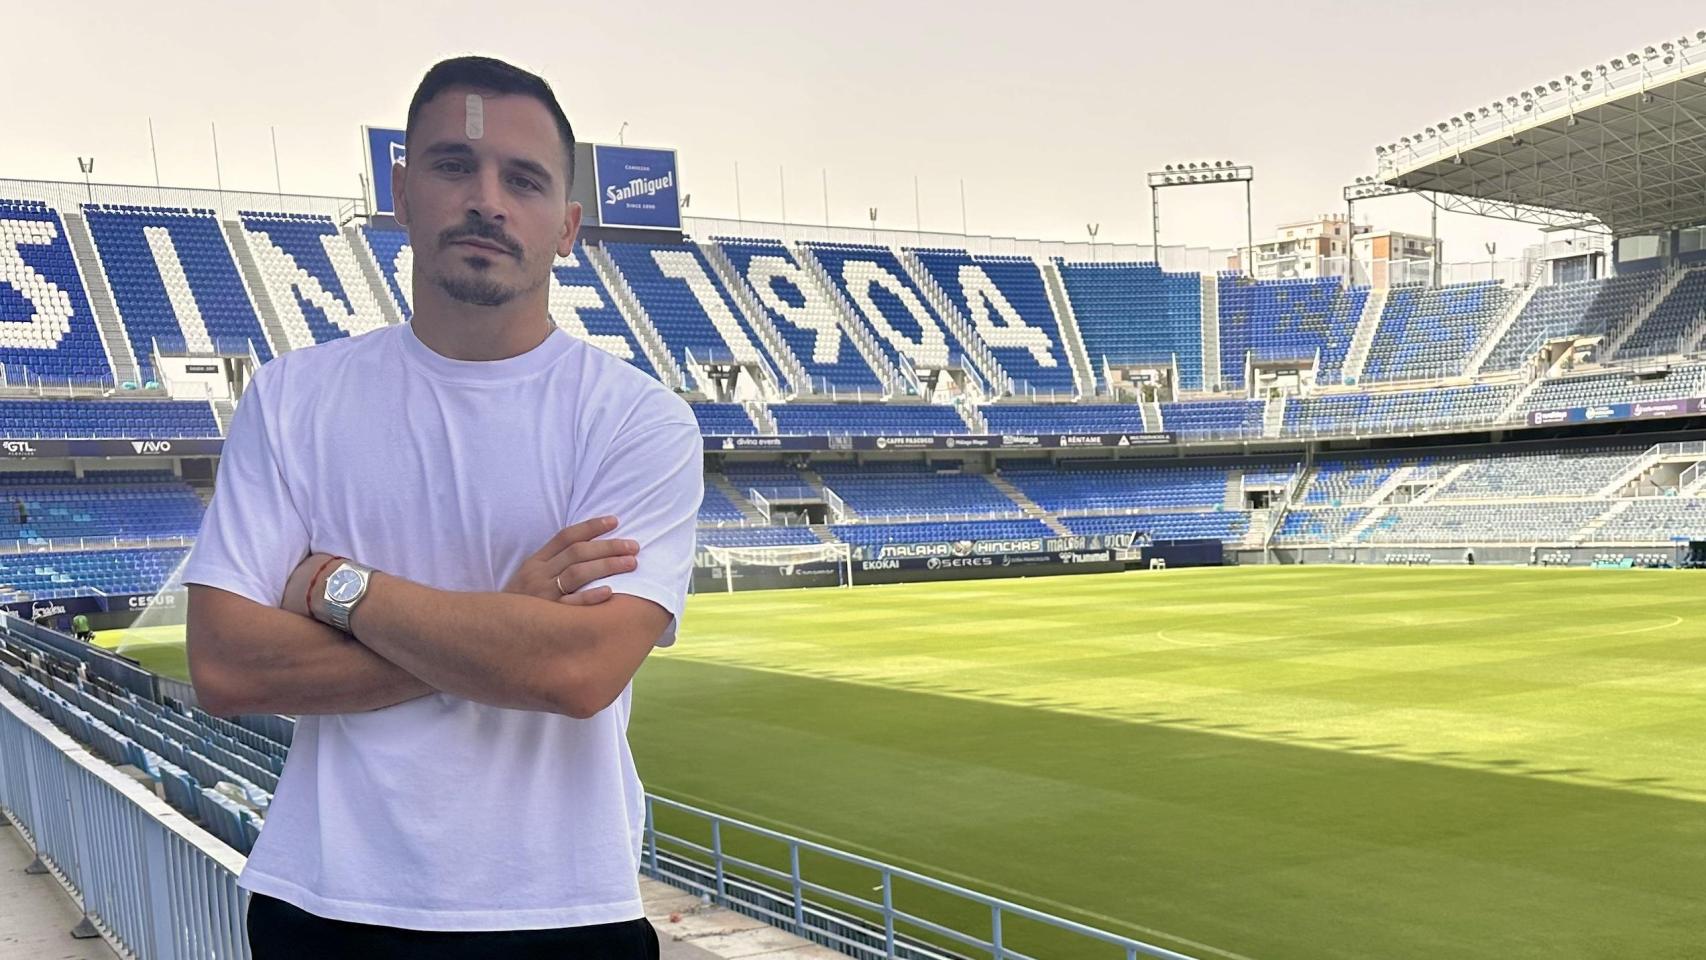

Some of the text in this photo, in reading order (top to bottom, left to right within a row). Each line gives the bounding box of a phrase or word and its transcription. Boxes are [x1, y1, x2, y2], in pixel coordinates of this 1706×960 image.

[650, 249, 1059, 369] 1904
[941, 557, 993, 568] SERES
[128, 594, 175, 607] CESUR
